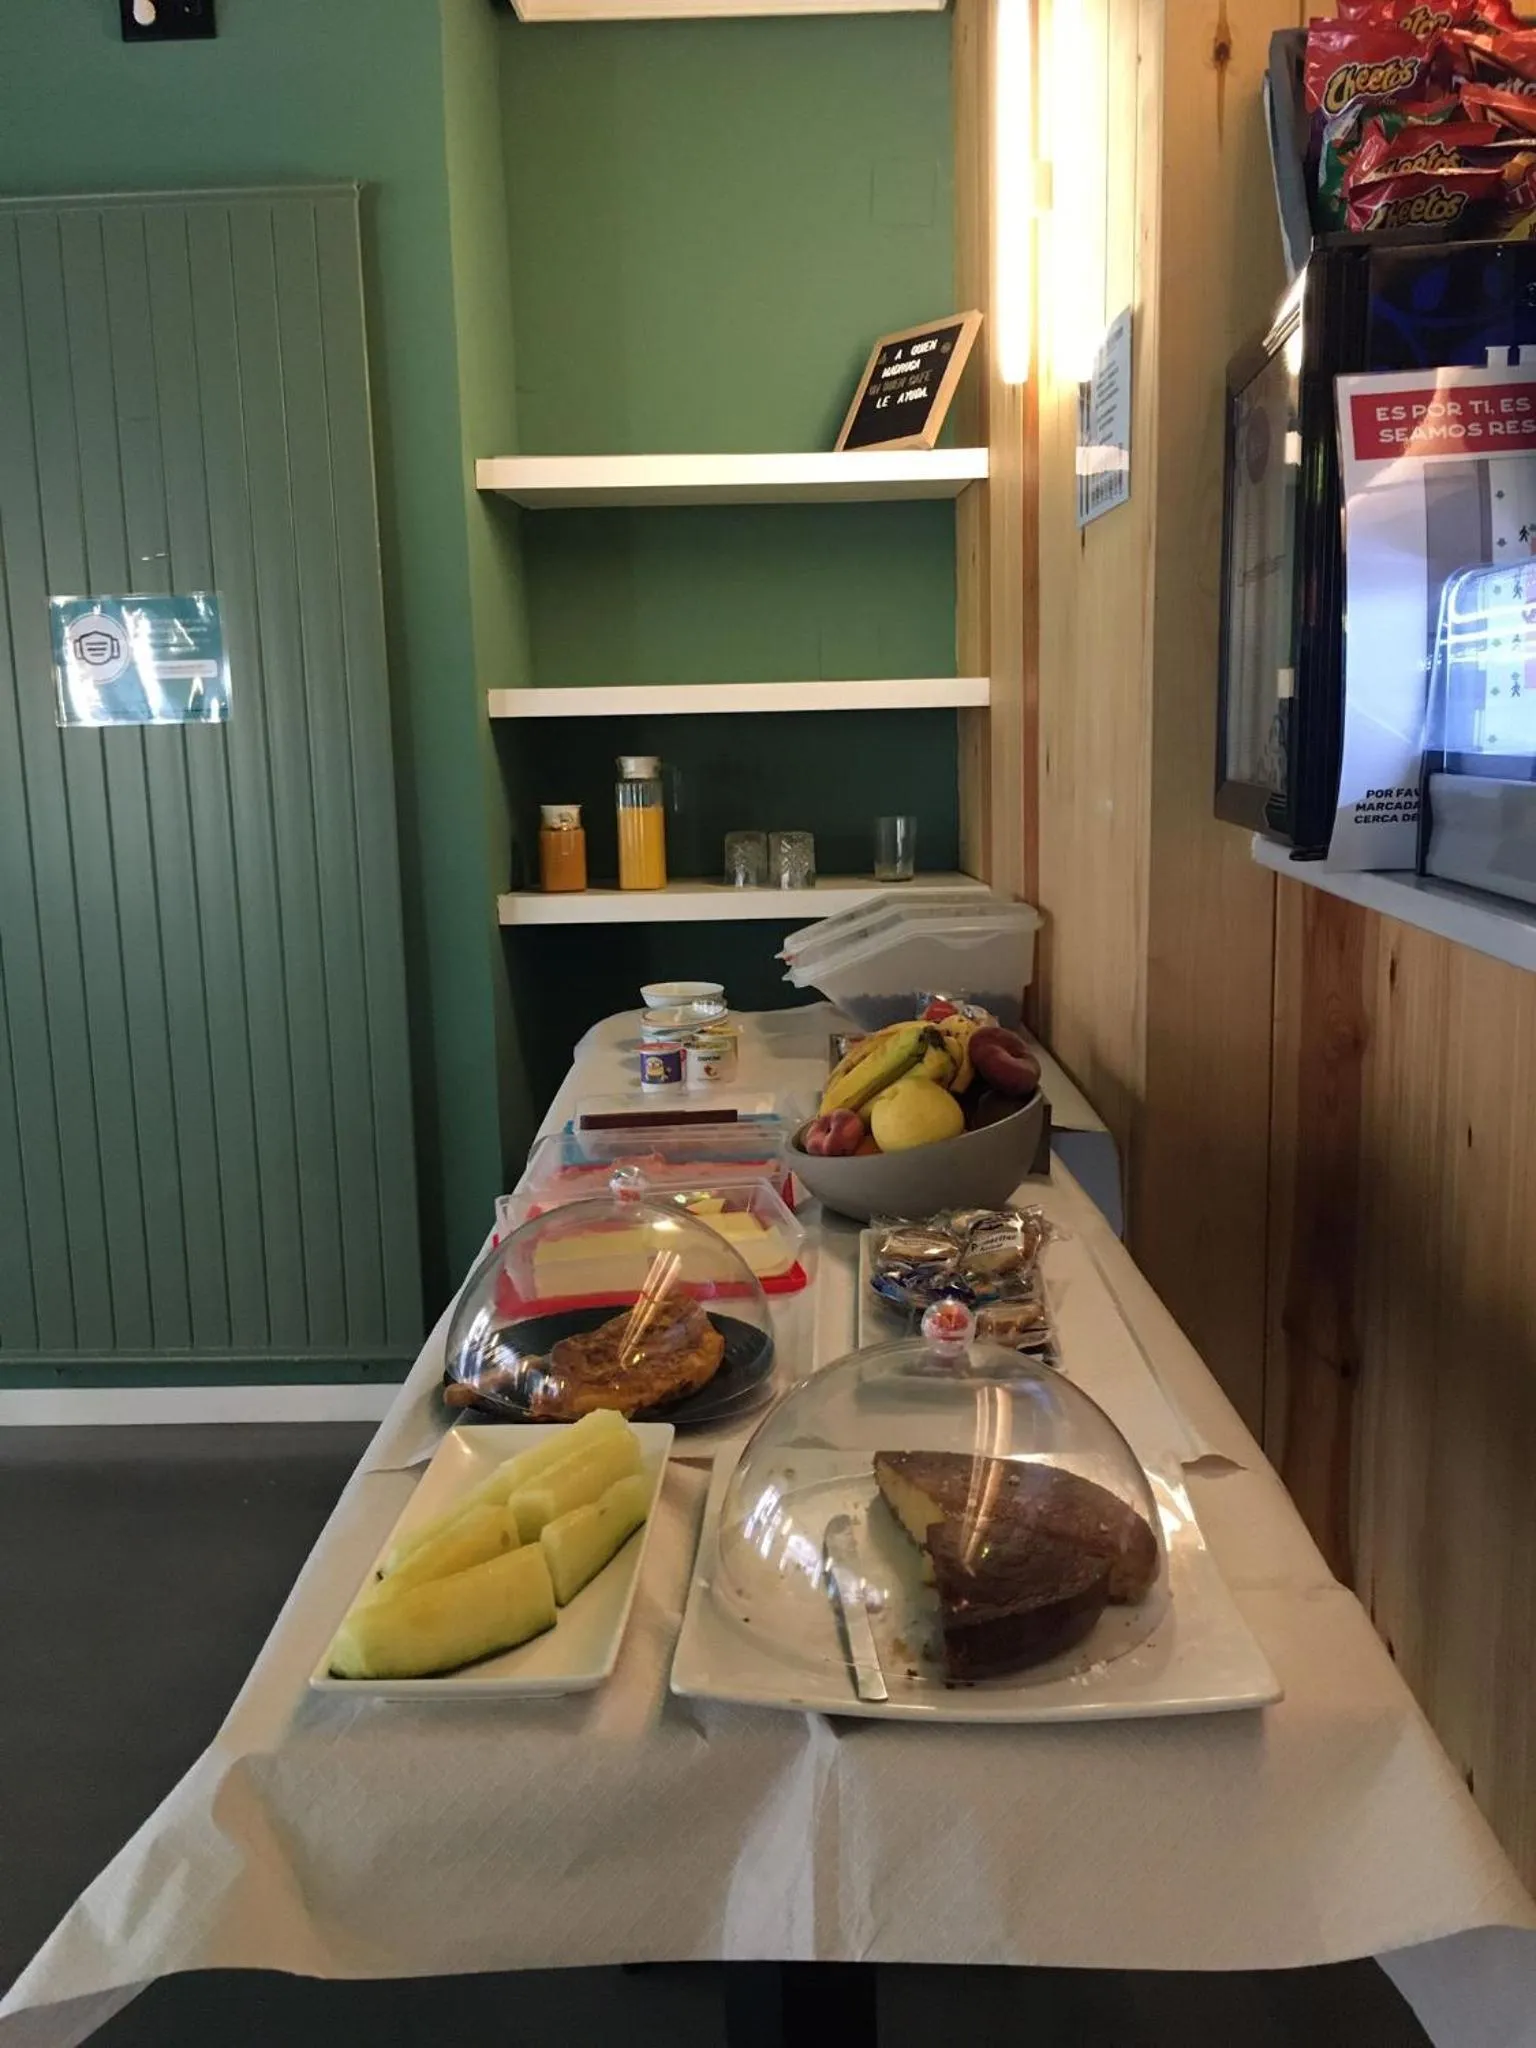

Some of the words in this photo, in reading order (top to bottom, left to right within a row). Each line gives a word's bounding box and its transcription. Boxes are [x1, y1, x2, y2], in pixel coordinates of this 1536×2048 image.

[1324, 57, 1418, 114] Cheetos
[876, 395, 890, 409] LE
[1376, 407, 1406, 422] ES
[1412, 402, 1463, 419] POR
[1469, 400, 1495, 415] TI,
[1500, 397, 1531, 412] ES
[1379, 422, 1483, 443] SEAMOS
[1488, 419, 1536, 436] RES
[1366, 789, 1393, 798] POR
[1354, 814, 1398, 824] CERCA
